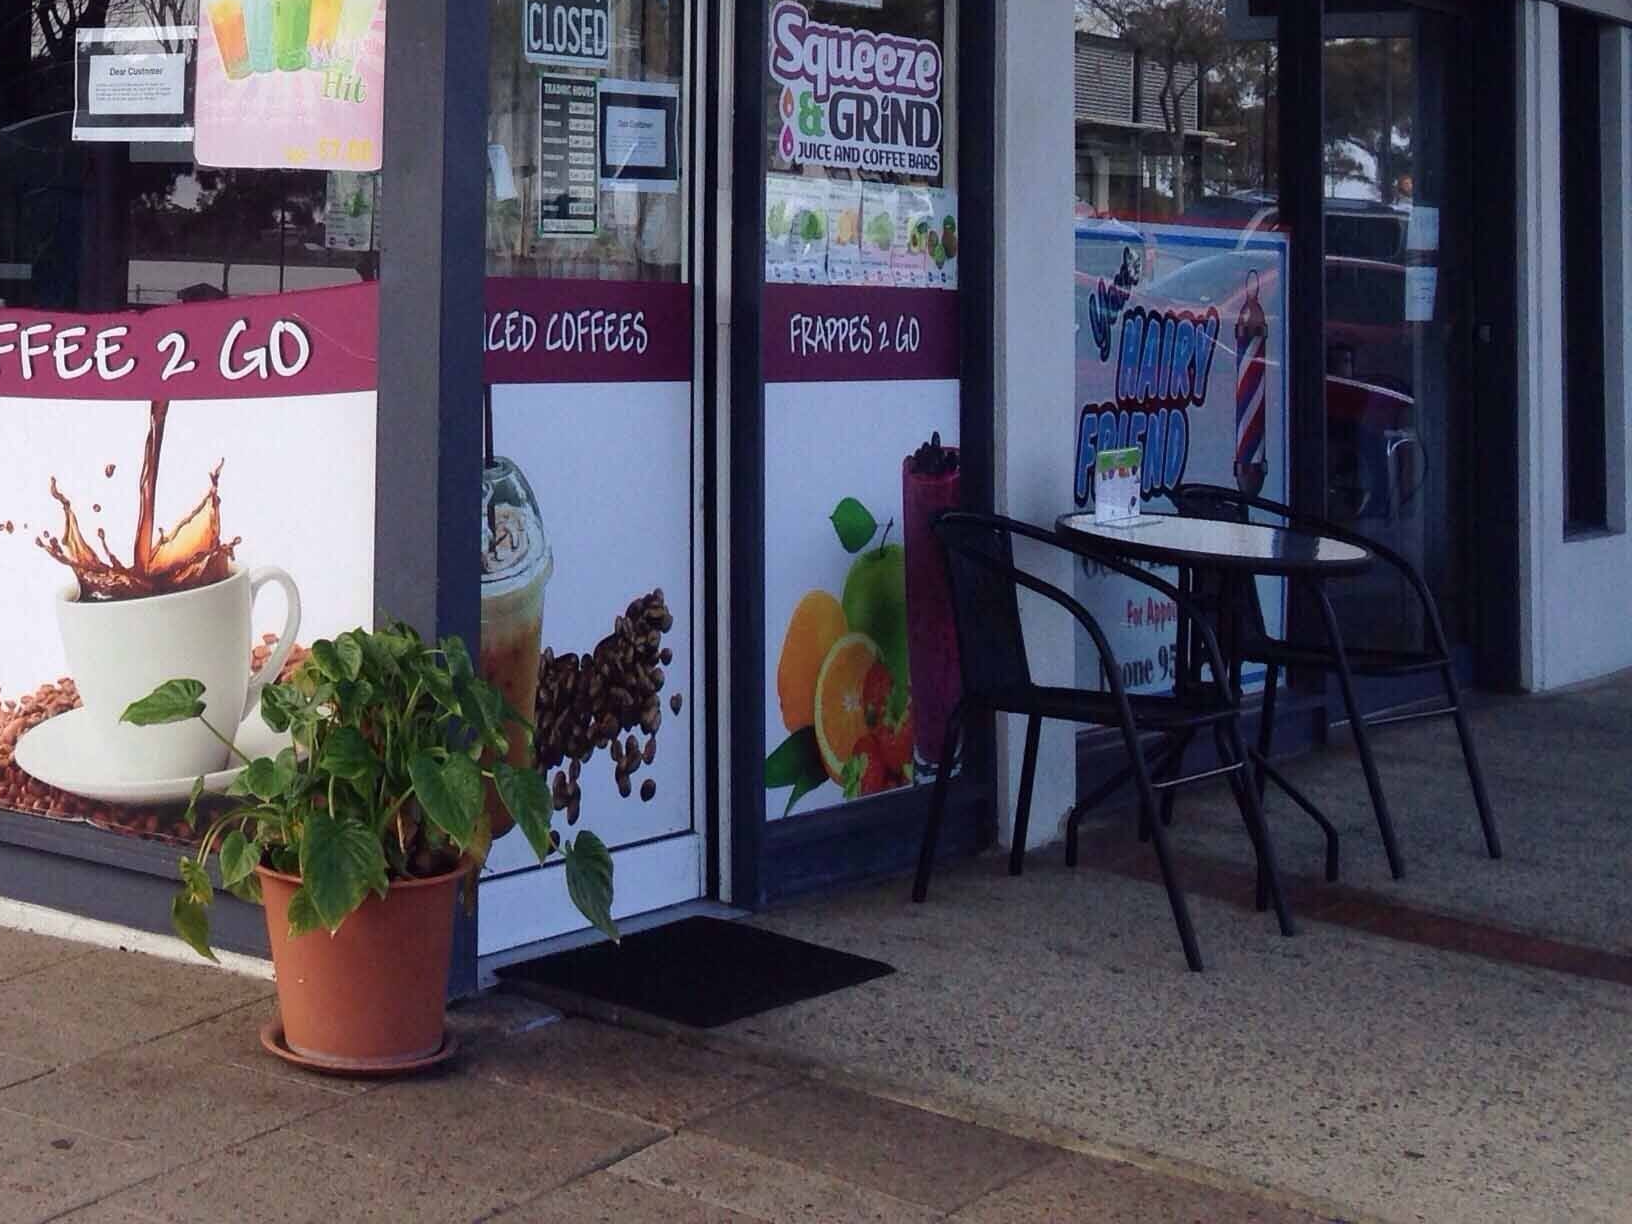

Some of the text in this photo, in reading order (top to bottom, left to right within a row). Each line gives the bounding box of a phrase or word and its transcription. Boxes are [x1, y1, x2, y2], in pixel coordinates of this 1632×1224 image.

[529, 2, 608, 56] CLOSED
[773, 5, 940, 103] Squeeze
[321, 70, 367, 104] Hit
[799, 91, 825, 137] &
[798, 142, 938, 171] JUICE AND COFFEE BARS
[157, 333, 196, 382] 2
[219, 318, 311, 381] GO
[546, 310, 648, 355] COFFEES
[791, 314, 920, 356] FRAPPES 2 GO
[1116, 306, 1219, 406] HAIRY
